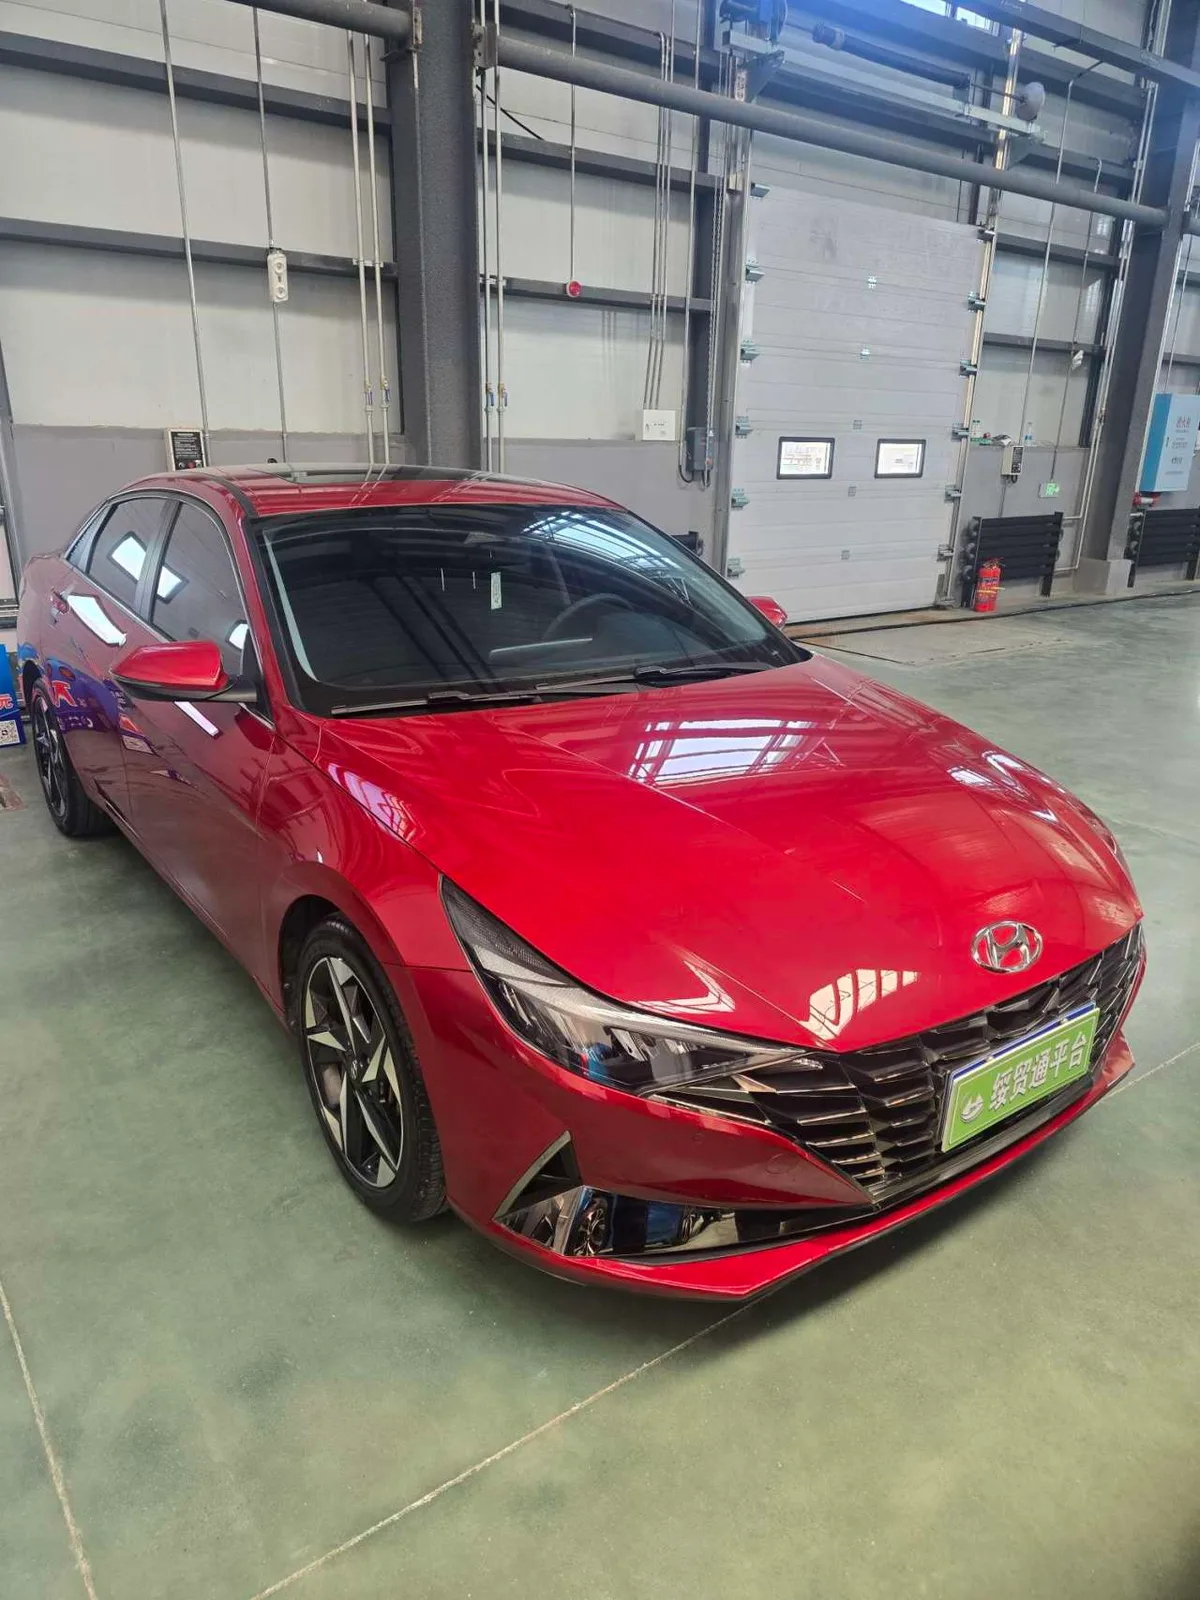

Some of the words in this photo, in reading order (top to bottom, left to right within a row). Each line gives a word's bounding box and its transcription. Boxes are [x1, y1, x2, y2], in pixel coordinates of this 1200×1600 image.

[989, 1031, 1087, 1111] 绥贸通平台
